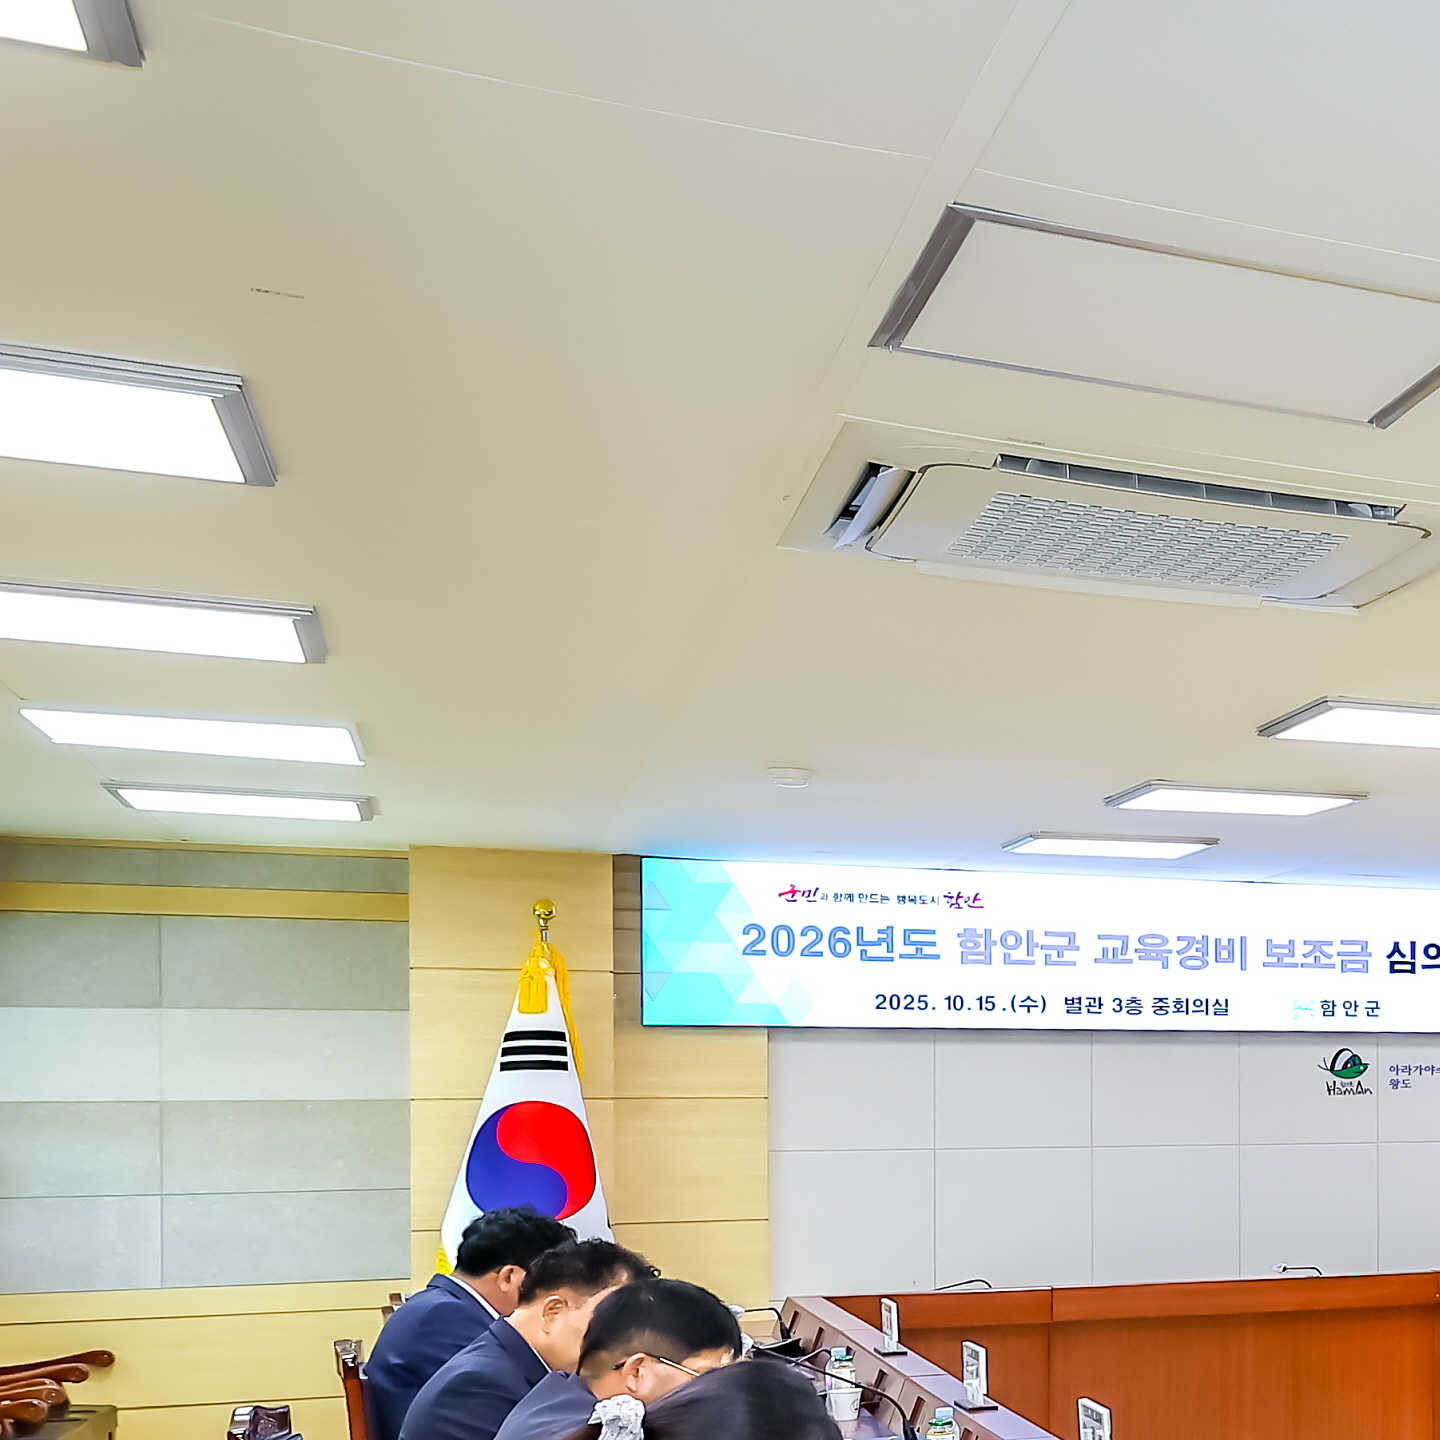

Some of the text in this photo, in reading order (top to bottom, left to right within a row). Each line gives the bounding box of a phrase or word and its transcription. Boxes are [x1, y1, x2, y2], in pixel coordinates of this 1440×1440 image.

[778, 884, 828, 903] 군민과
[833, 892, 854, 903] 함께
[858, 892, 890, 904] 만드는
[943, 891, 984, 910] 함안
[741, 923, 941, 962] 2026년도
[957, 927, 1080, 966] 함안군
[1093, 933, 1248, 971] 교육경비
[1262, 937, 1372, 974] 보조금
[1064, 996, 1104, 1015] 별관
[1112, 997, 1144, 1016] 3층
[1151, 996, 1230, 1017] 중회의실
[1325, 1080, 1374, 1097] HamAn
[1388, 1078, 1413, 1090] 왕도
